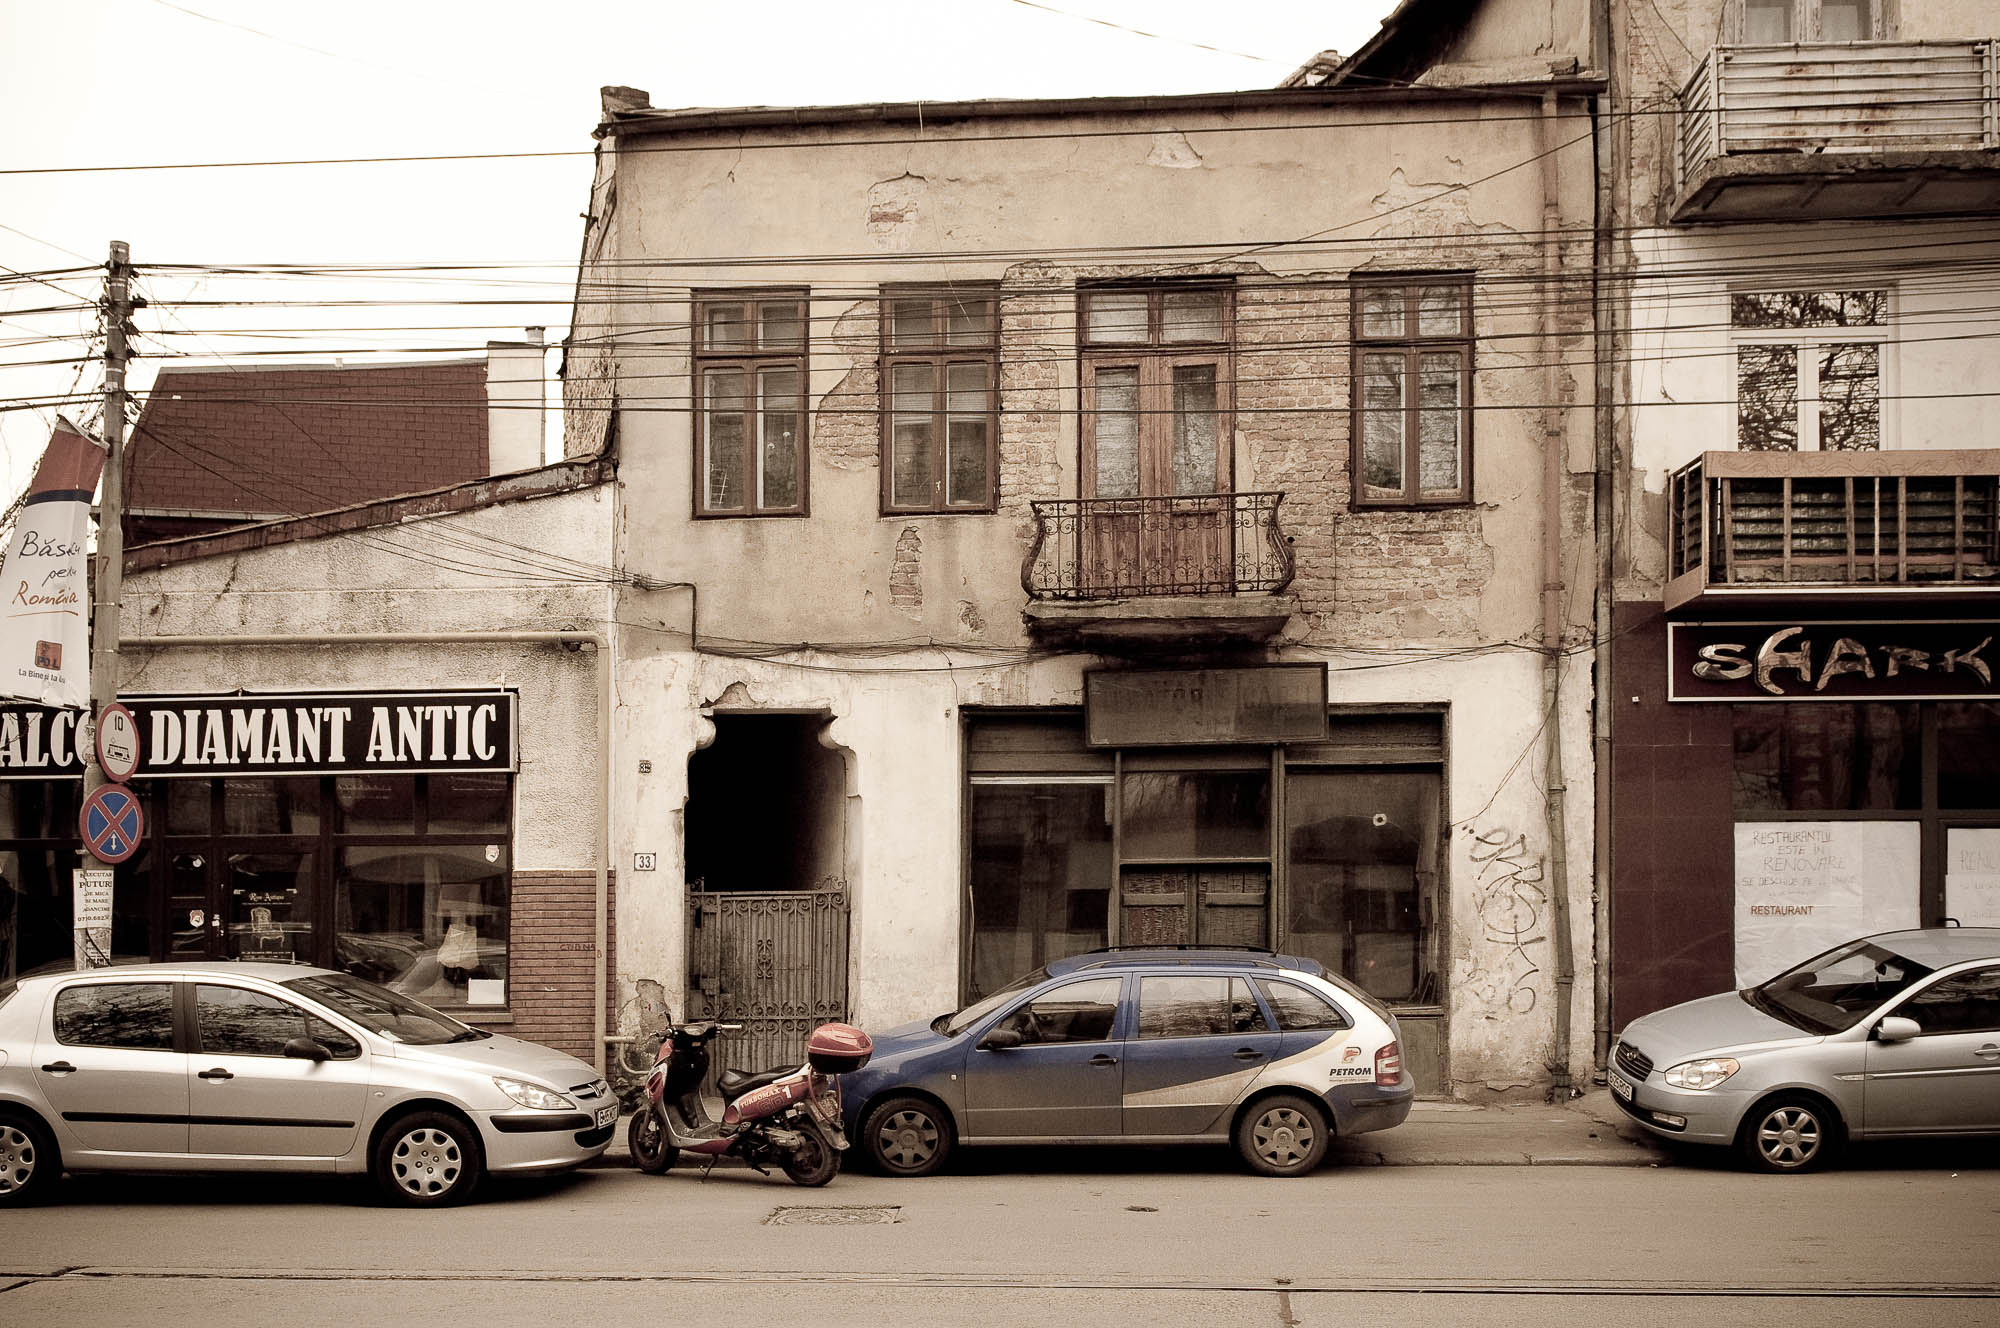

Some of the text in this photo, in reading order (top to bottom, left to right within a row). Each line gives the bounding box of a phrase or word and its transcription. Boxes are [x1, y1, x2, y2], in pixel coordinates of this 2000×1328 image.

[1692, 626, 1992, 695] SHARK
[114, 714, 124, 732] 10
[149, 707, 352, 765] DIAMANT
[365, 704, 497, 762] ANTIC
[639, 855, 651, 869] 33
[1751, 905, 1814, 916] RESTAURANT
[1329, 1067, 1371, 1076] PETROM
[740, 1087, 781, 1109] TURBOMAX
